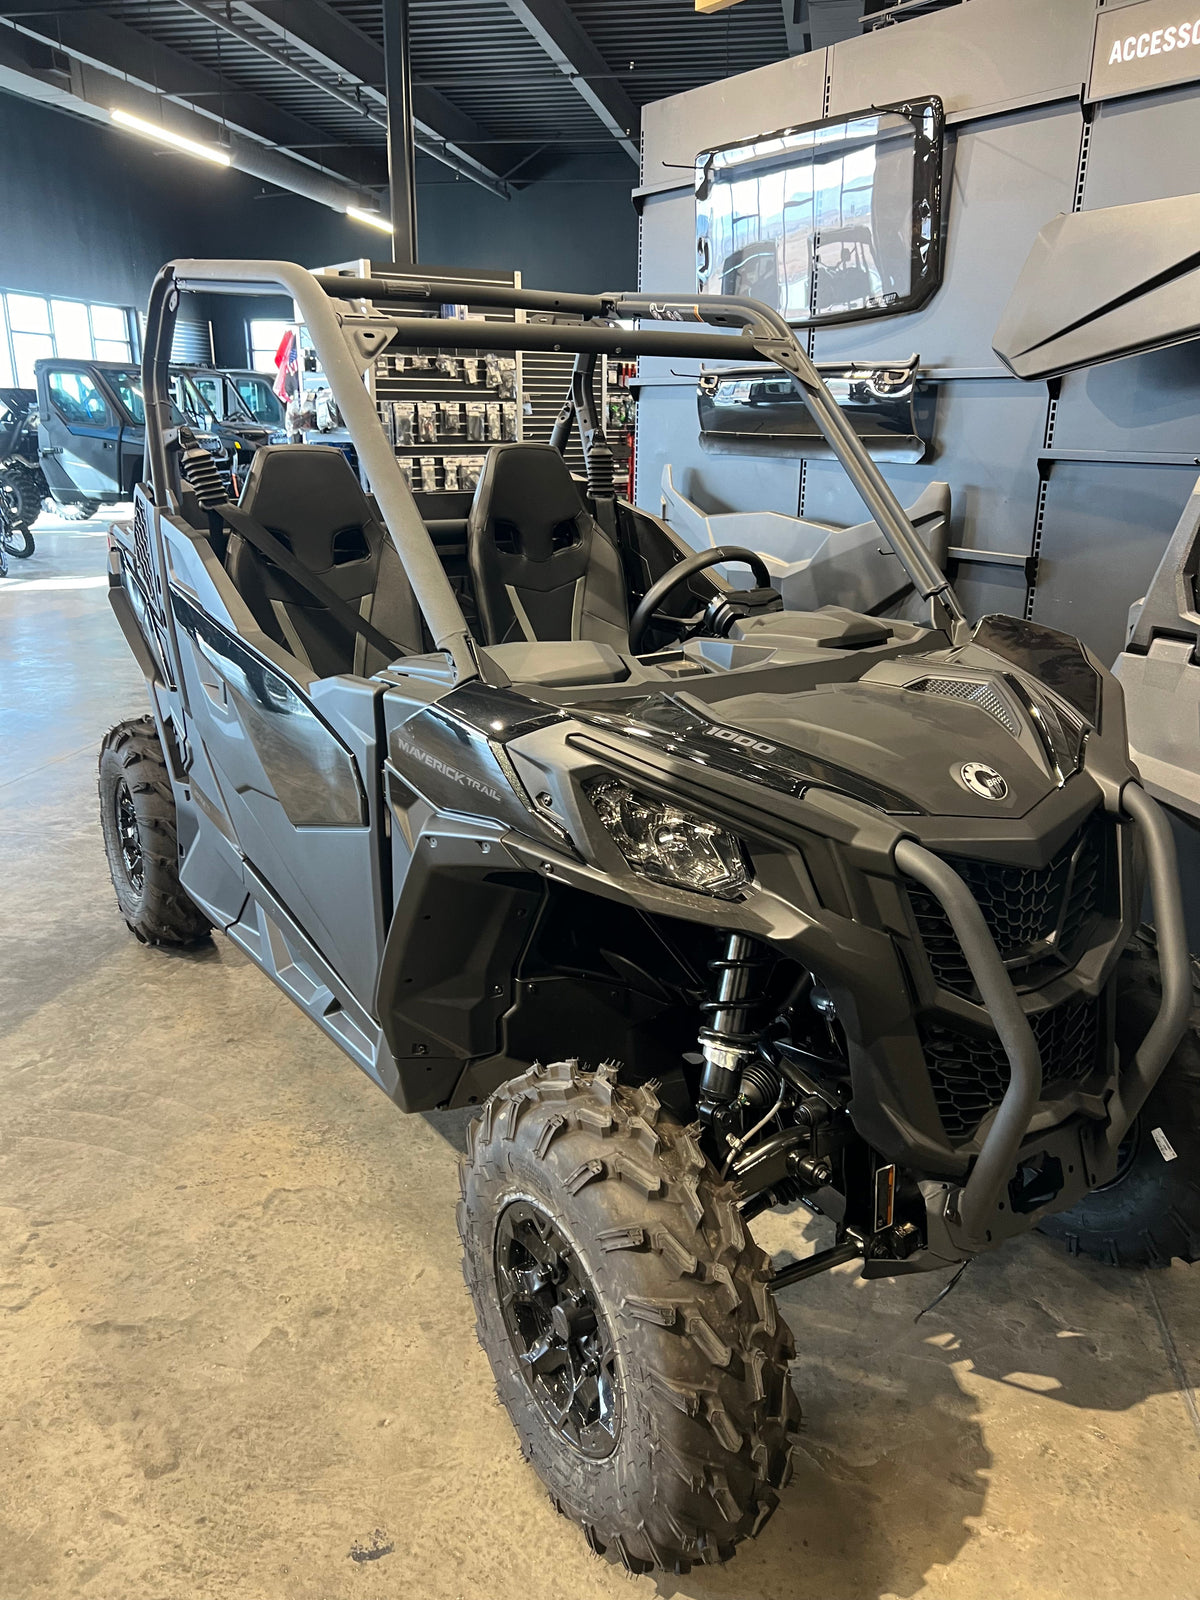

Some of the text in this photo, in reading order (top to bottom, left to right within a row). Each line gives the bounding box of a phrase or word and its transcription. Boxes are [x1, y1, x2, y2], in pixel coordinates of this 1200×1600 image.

[703, 727, 777, 754] 1000
[398, 738, 501, 802] MAVERICK TRAIL
[986, 776, 1003, 787] BRP
